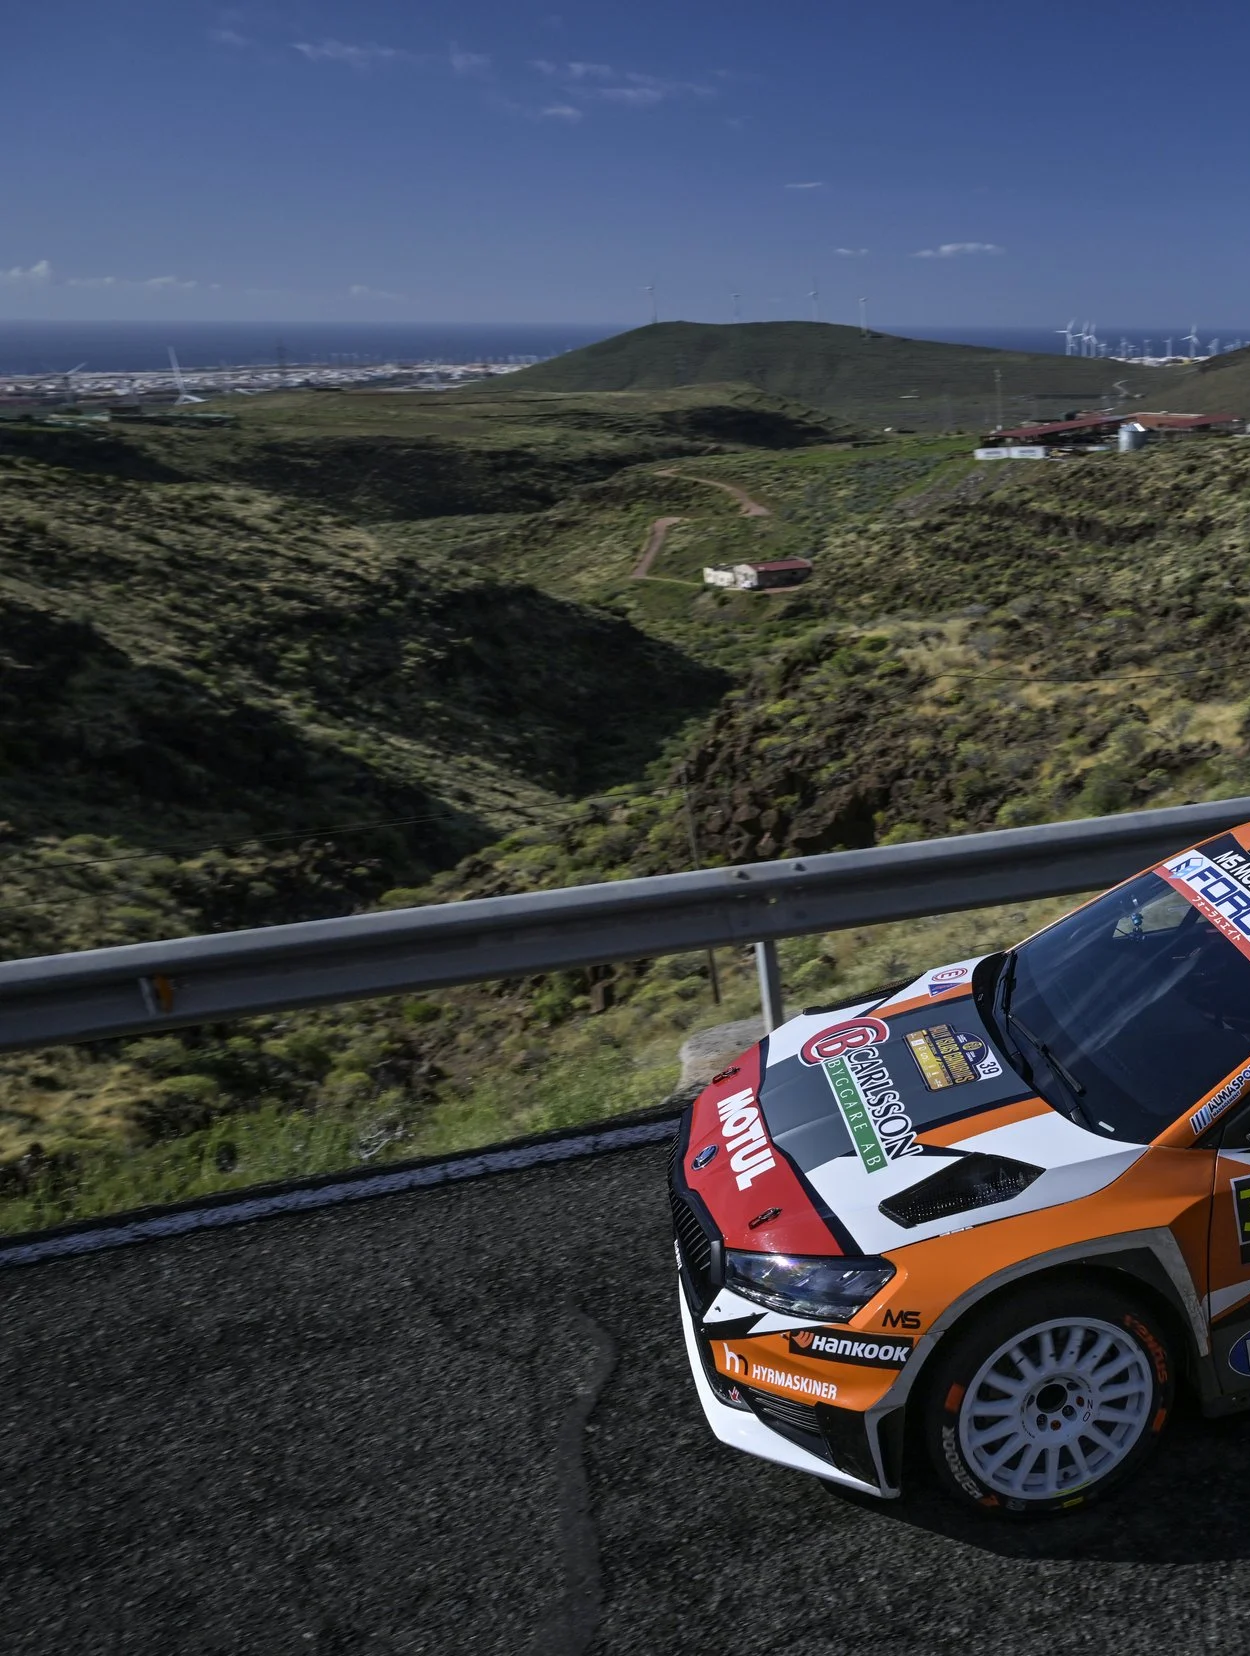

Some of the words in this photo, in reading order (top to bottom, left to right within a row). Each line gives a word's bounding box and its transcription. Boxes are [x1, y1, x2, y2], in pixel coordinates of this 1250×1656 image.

[1212, 850, 1246, 870] MS
[979, 1061, 1000, 1075] 39
[827, 1059, 868, 1132] BYGGARE
[860, 1142, 882, 1166] AB
[847, 1047, 924, 1160] CARLSSON
[717, 1087, 777, 1192] MOTUL
[881, 1309, 922, 1329] MS
[751, 1363, 838, 1400] HYRMASKINER
